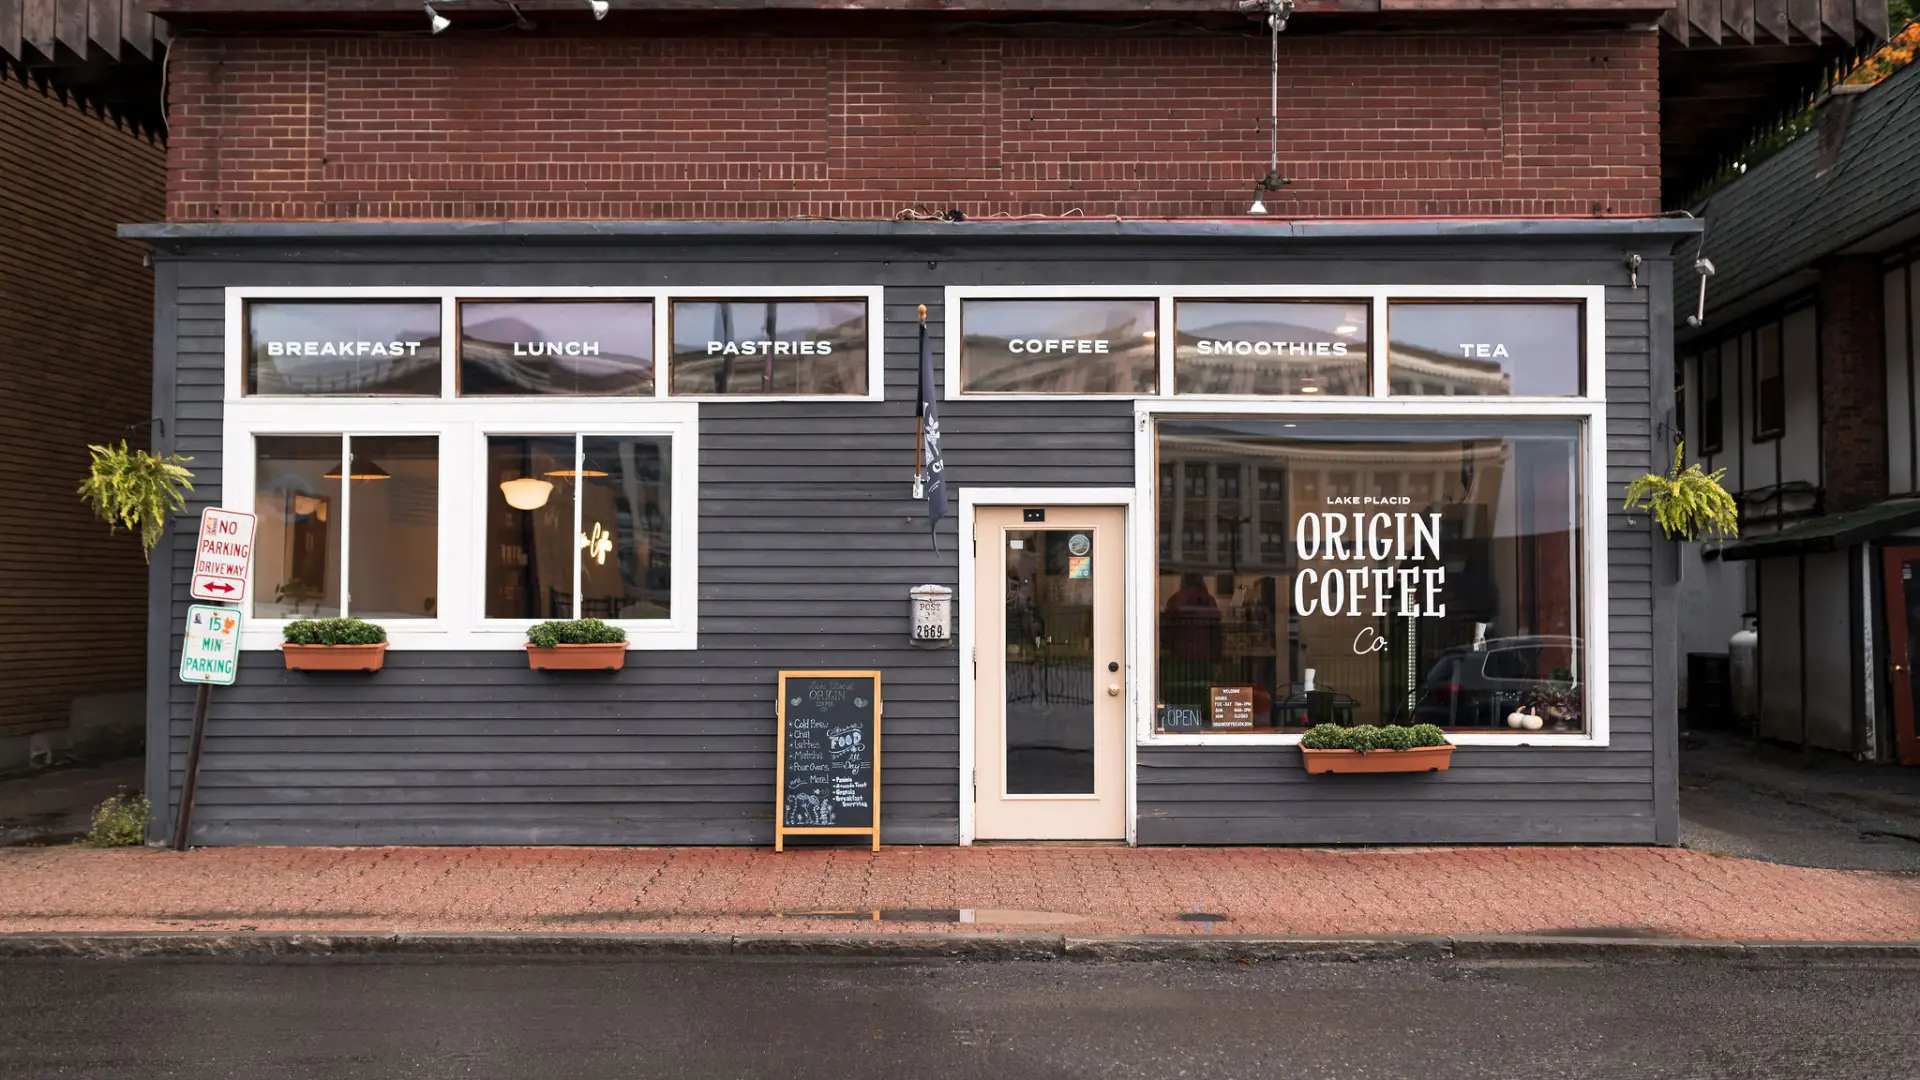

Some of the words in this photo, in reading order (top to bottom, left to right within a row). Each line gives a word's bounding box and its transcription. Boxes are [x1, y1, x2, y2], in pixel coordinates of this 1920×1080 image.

[267, 341, 421, 356] BREAKFAST
[513, 341, 600, 356] LUNCH
[707, 340, 833, 355] PASTRIES
[1008, 338, 1110, 354] COFFEE
[1196, 340, 1348, 357] SMOOTHIES
[1459, 343, 1509, 358] TEA
[1327, 496, 1360, 505] LAKE
[1364, 496, 1411, 505] PLACID
[219, 520, 238, 535] NO
[1296, 512, 1443, 561] ORIGIN
[202, 539, 248, 559] PARKING
[199, 560, 245, 577] DRIVEWAY
[1294, 565, 1446, 618] COFFEE
[920, 603, 941, 611] POST
[209, 616, 222, 631] 15
[917, 624, 943, 638] 2669
[202, 637, 222, 653] MIN
[1353, 626, 1388, 655] Co.
[185, 657, 232, 674] PARKING
[809, 689, 846, 701] ORIGIN
[794, 718, 810, 729] Cold
[810, 719, 829, 729] Brew
[1167, 709, 1200, 726] OPEN
[794, 739, 821, 749] Lattes
[829, 732, 862, 750] FOOD
[794, 751, 823, 760] Matcha
